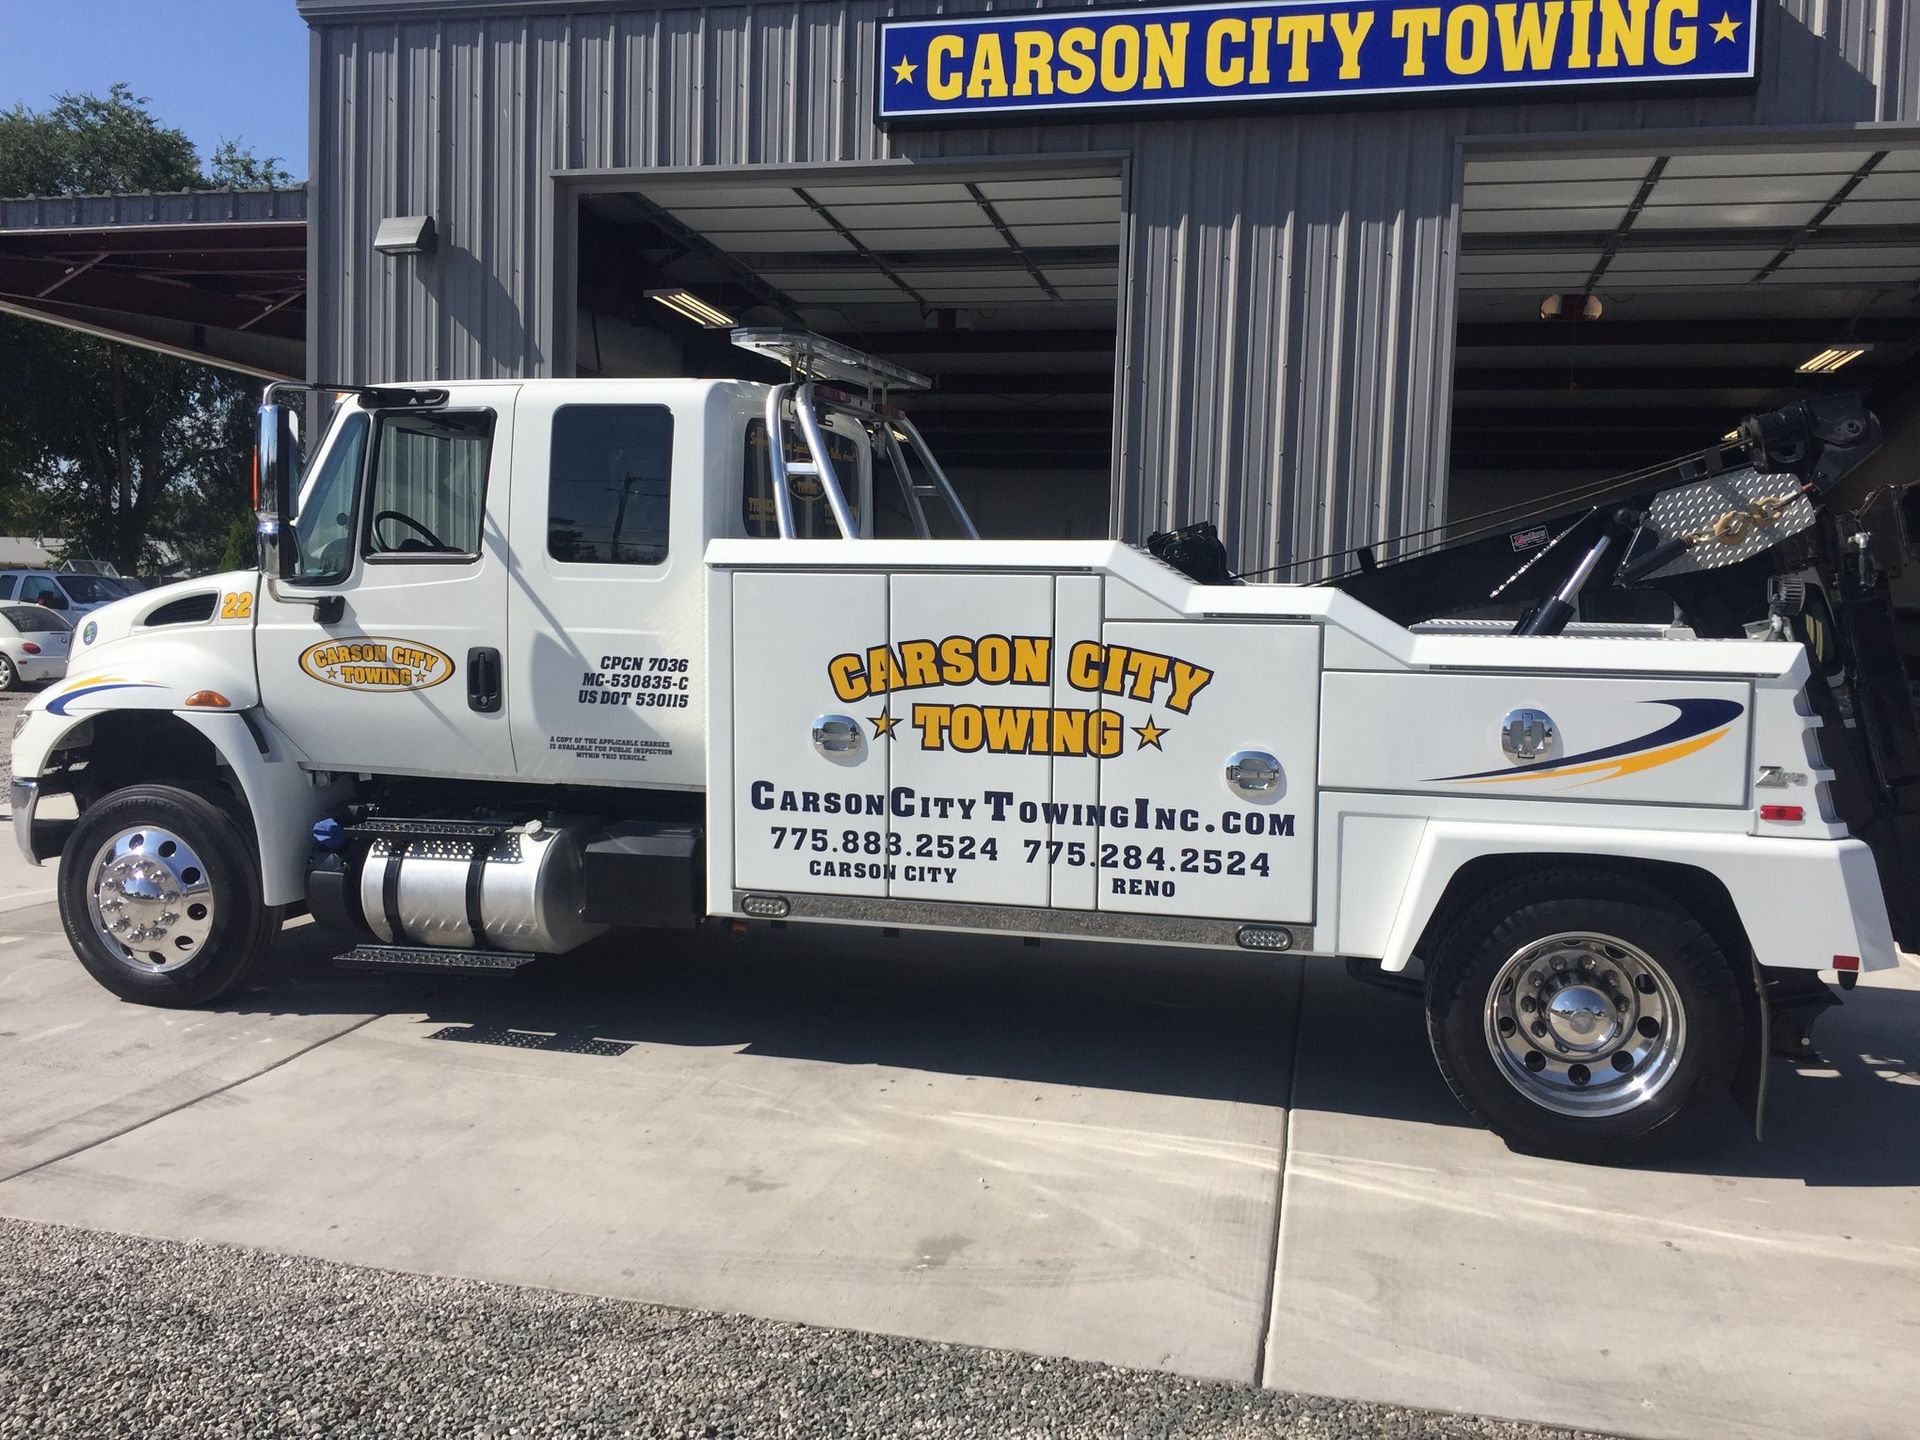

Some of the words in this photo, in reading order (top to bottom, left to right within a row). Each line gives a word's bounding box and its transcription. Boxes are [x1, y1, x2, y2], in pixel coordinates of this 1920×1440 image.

[927, 22, 1190, 101] CARSON
[1205, 11, 1375, 87] CITY
[1391, 0, 1699, 77] TOWING
[221, 592, 253, 619] 22
[313, 643, 388, 669] CARSON
[391, 646, 439, 672] CITY
[600, 656, 644, 671] CPCN
[648, 657, 690, 673] 7036
[340, 665, 412, 686] TOWING
[582, 672, 690, 691] MC-530835-C
[828, 634, 1054, 704] CARSON
[1066, 639, 1215, 716] CITY
[578, 689, 598, 704] US
[599, 690, 632, 706] DOT
[635, 692, 690, 708] 530115
[584, 737, 597, 745] THE
[598, 738, 639, 747] APPLICABLE
[640, 740, 670, 748] CHARGES
[911, 702, 1125, 759] TOWING
[576, 751, 600, 759] WITHIN
[608, 746, 632, 754] PUBLIC
[770, 826, 999, 861] 775.883.2524
[1023, 839, 1270, 877] 775.284.2524
[809, 859, 897, 880] CARSON
[903, 865, 957, 884] CITY
[1111, 877, 1177, 898] RENO
